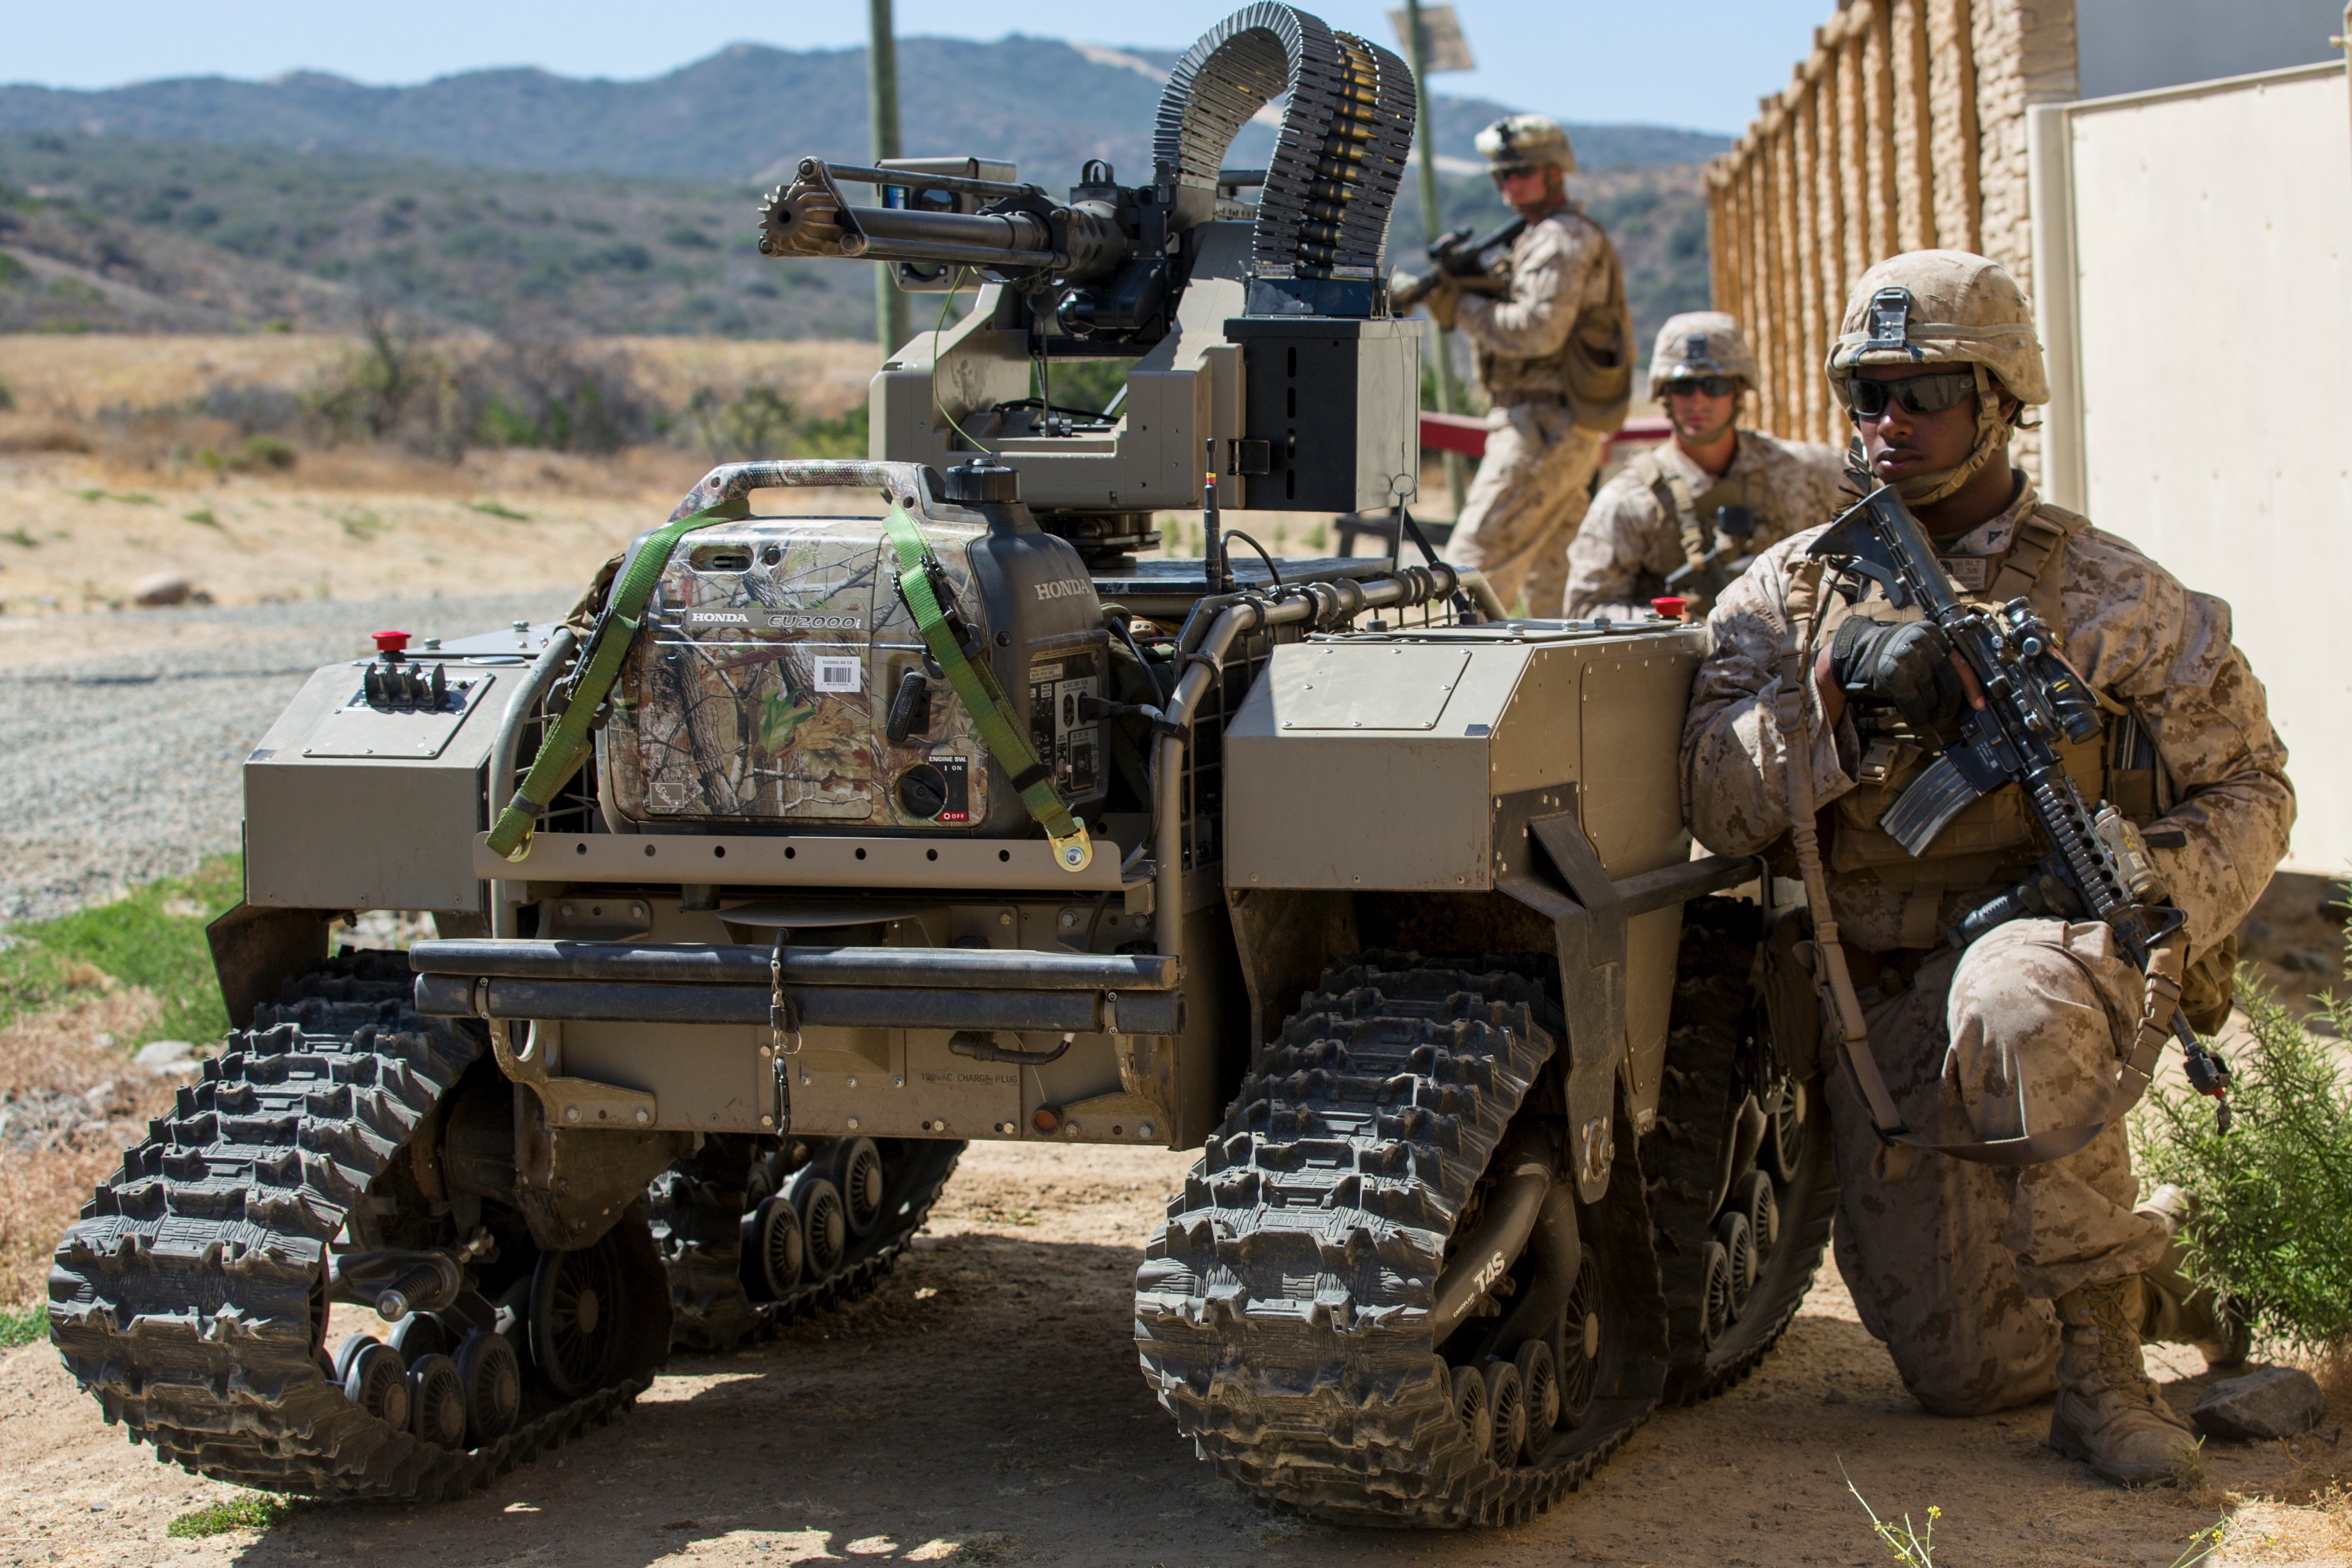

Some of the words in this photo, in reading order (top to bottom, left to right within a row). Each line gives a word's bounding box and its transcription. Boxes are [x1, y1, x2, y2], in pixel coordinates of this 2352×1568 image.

[1034, 578, 1091, 600] HONDA
[691, 613, 749, 622] HONDA
[768, 615, 861, 629] EU2000i
[957, 1073, 992, 1083] CHARGE
[995, 1075, 1018, 1083] PLUG
[1473, 1251, 1505, 1294] T4S
[1453, 1292, 1475, 1318] CAMOPLAST
